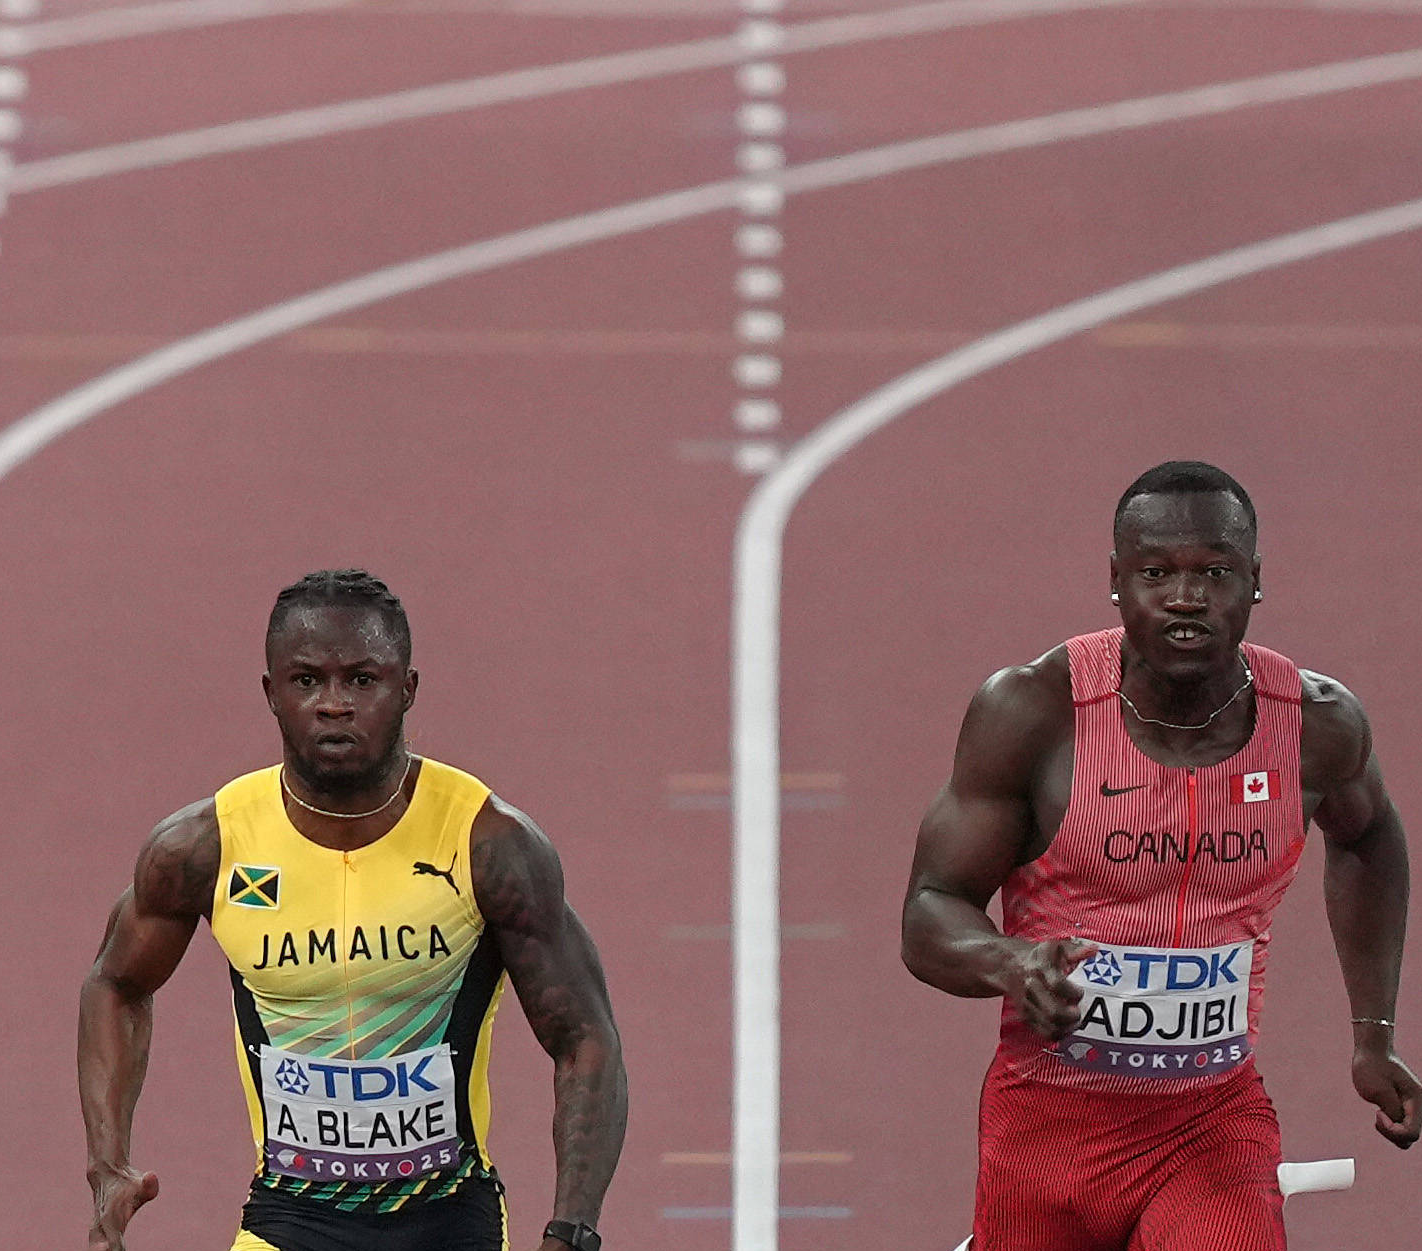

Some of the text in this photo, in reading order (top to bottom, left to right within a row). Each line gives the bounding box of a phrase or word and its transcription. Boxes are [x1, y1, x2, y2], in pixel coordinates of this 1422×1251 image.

[1104, 829, 1268, 863] CANADA
[253, 924, 452, 970] JAMAICA
[1124, 946, 1242, 990] TDK
[1078, 995, 1237, 1040] ADJIBI
[308, 1054, 440, 1101] TDK
[277, 1100, 446, 1149] A. BLAKE
